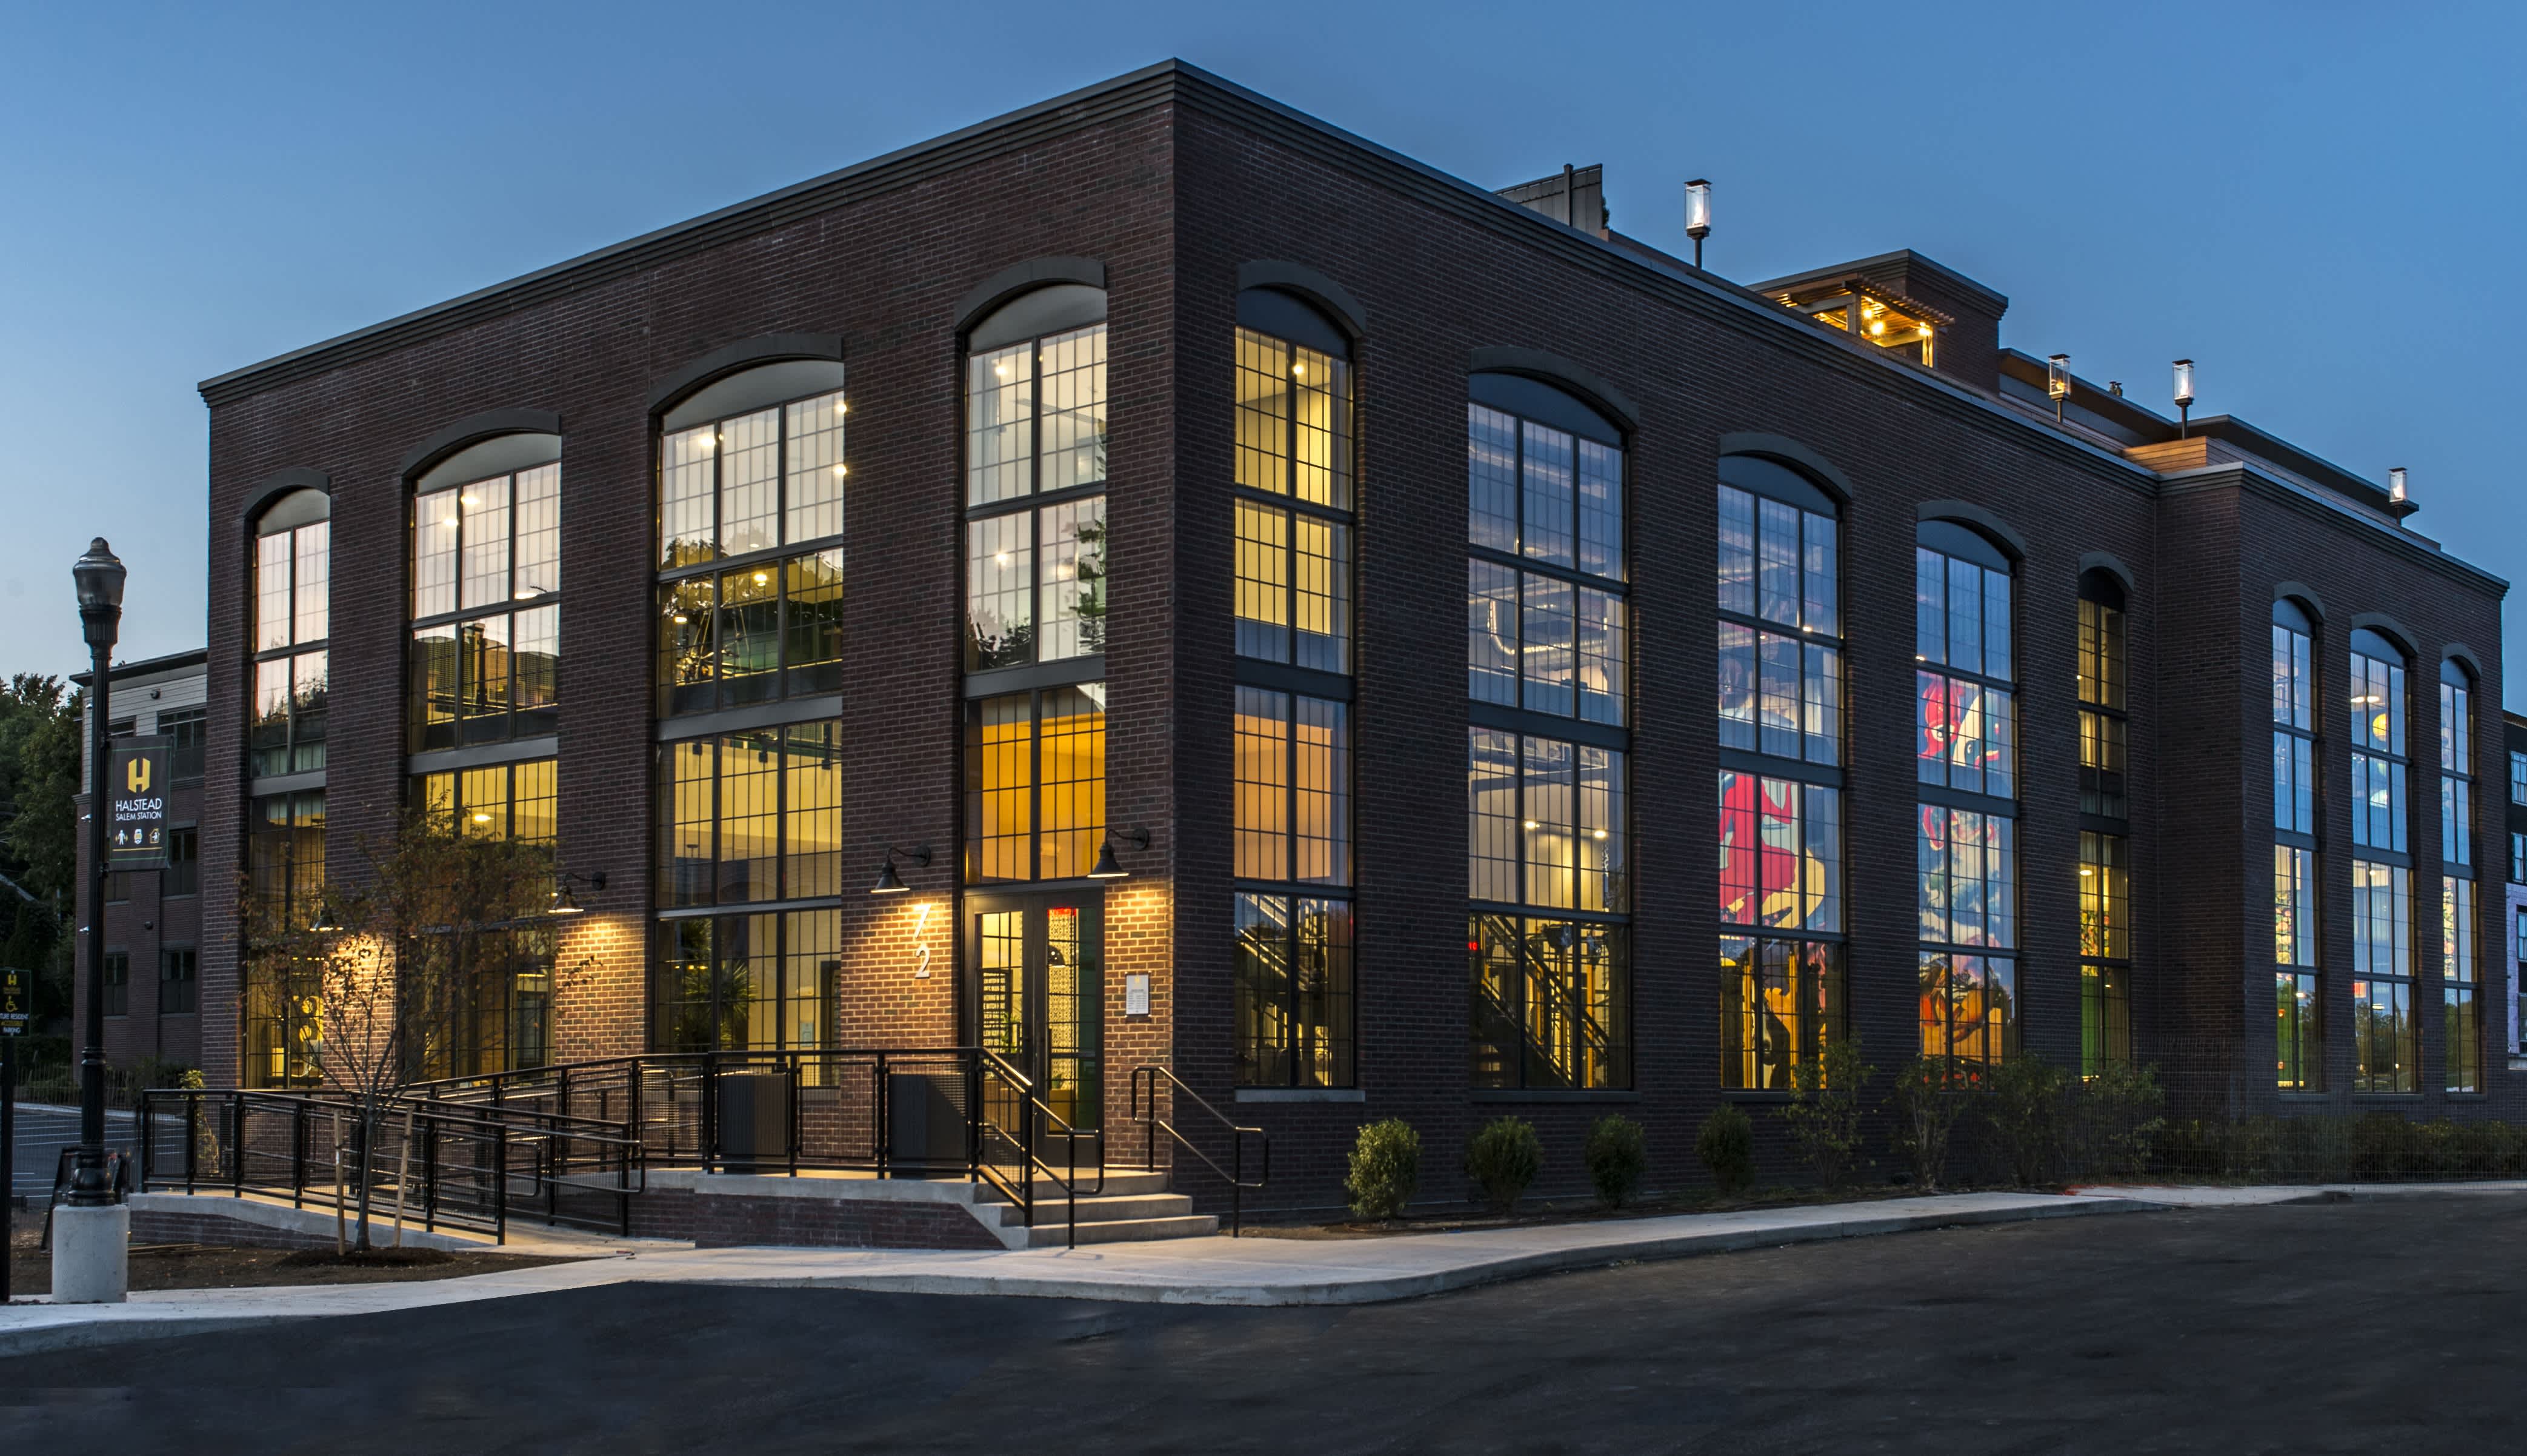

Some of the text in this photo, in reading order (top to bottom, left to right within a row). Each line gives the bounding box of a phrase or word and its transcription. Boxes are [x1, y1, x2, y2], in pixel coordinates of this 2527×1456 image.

[128, 757, 150, 793] H
[116, 798, 162, 812] HALSTEAD
[116, 811, 162, 821] SALEM STATION
[8, 974, 17, 985] H
